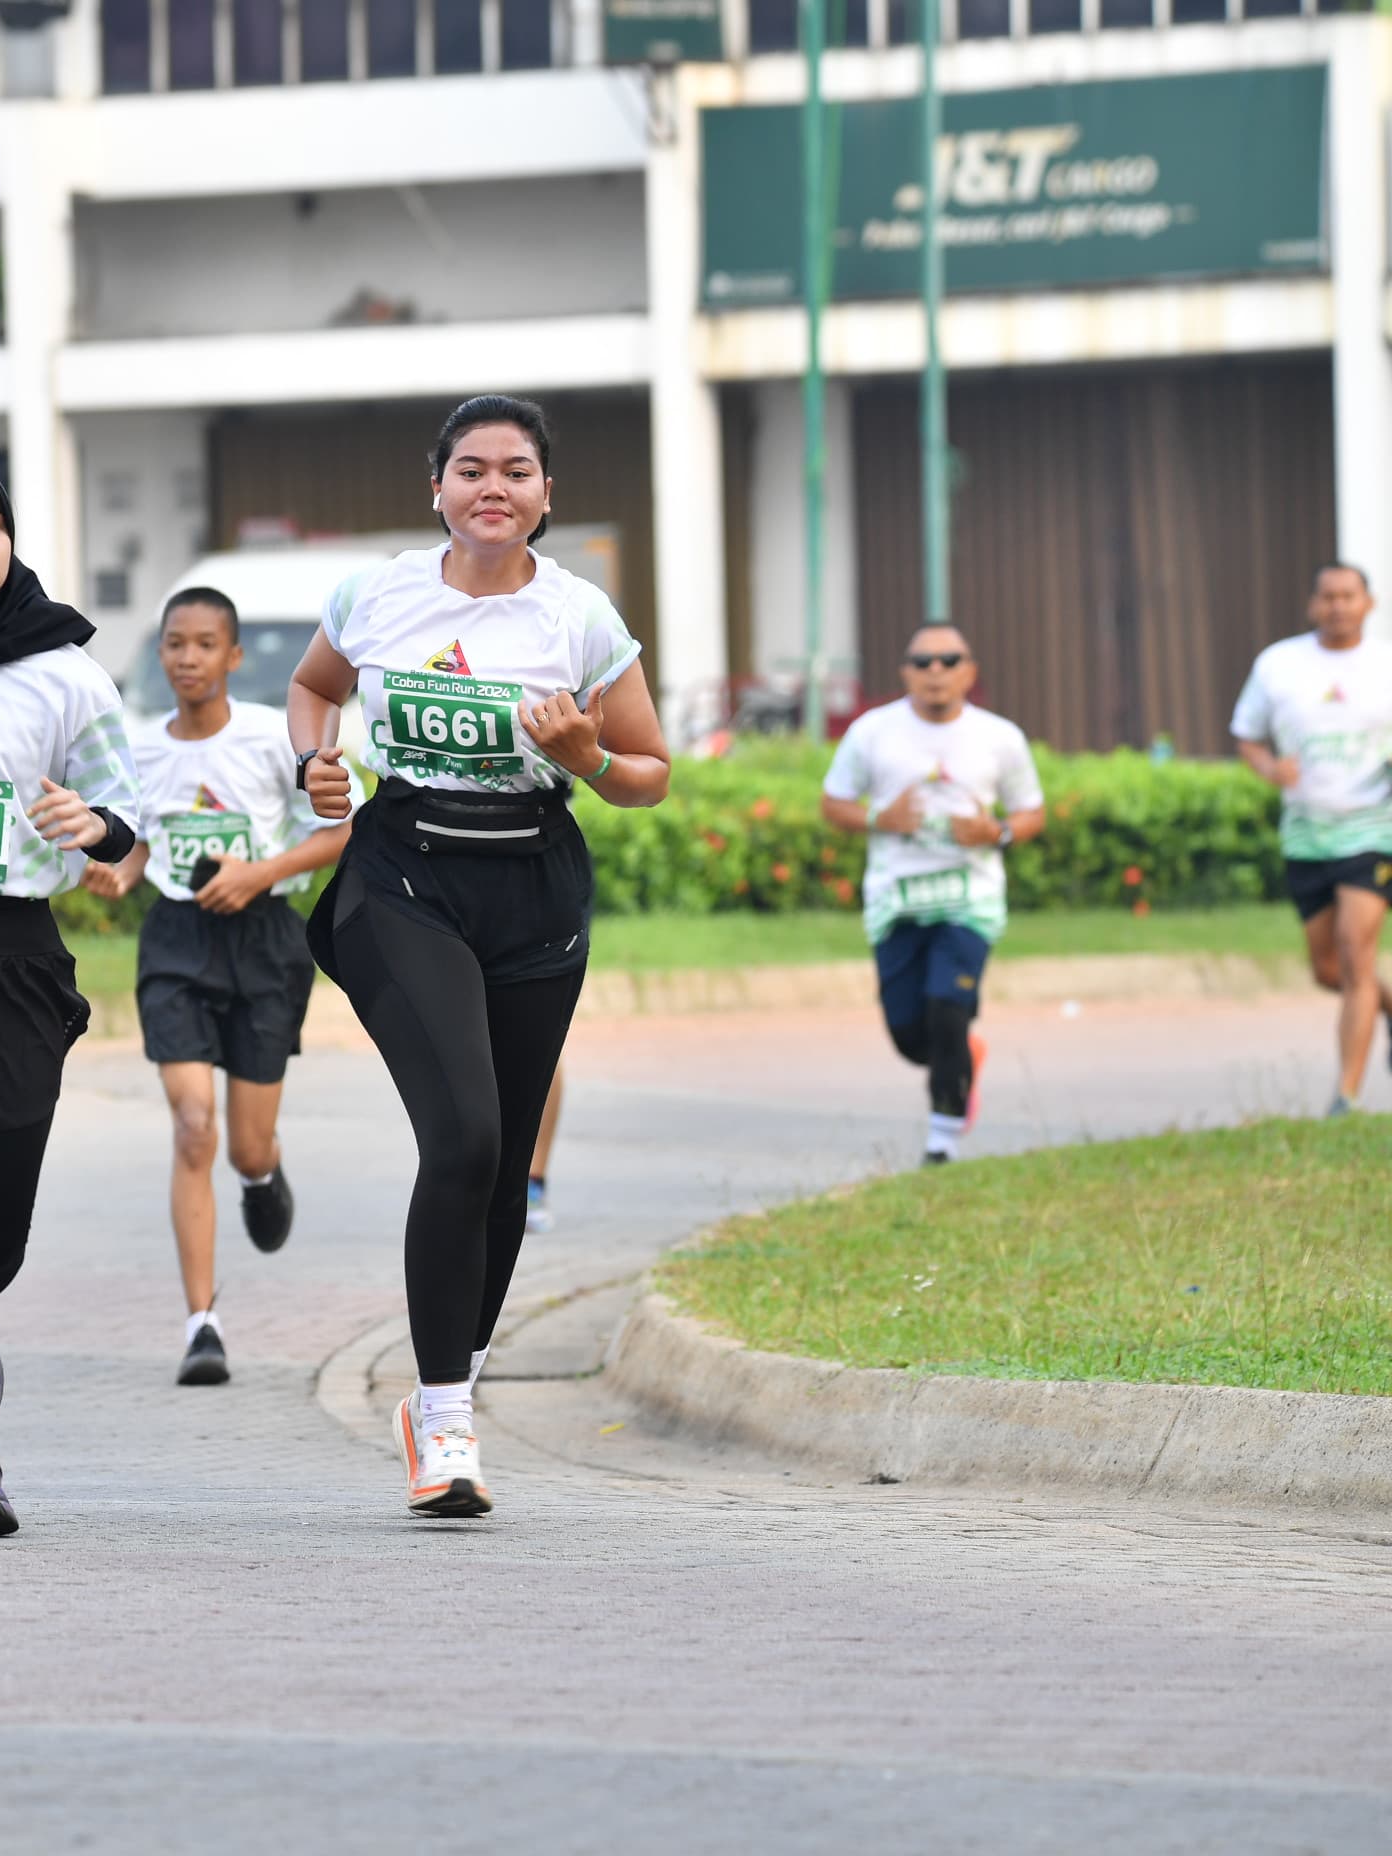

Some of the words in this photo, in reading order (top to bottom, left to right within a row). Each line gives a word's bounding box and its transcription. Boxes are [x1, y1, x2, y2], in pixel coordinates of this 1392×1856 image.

[391, 676, 425, 690] Cobra
[427, 680, 450, 692] Fun
[452, 682, 475, 695] Run
[476, 684, 511, 698] 2024
[401, 703, 498, 748] 1661
